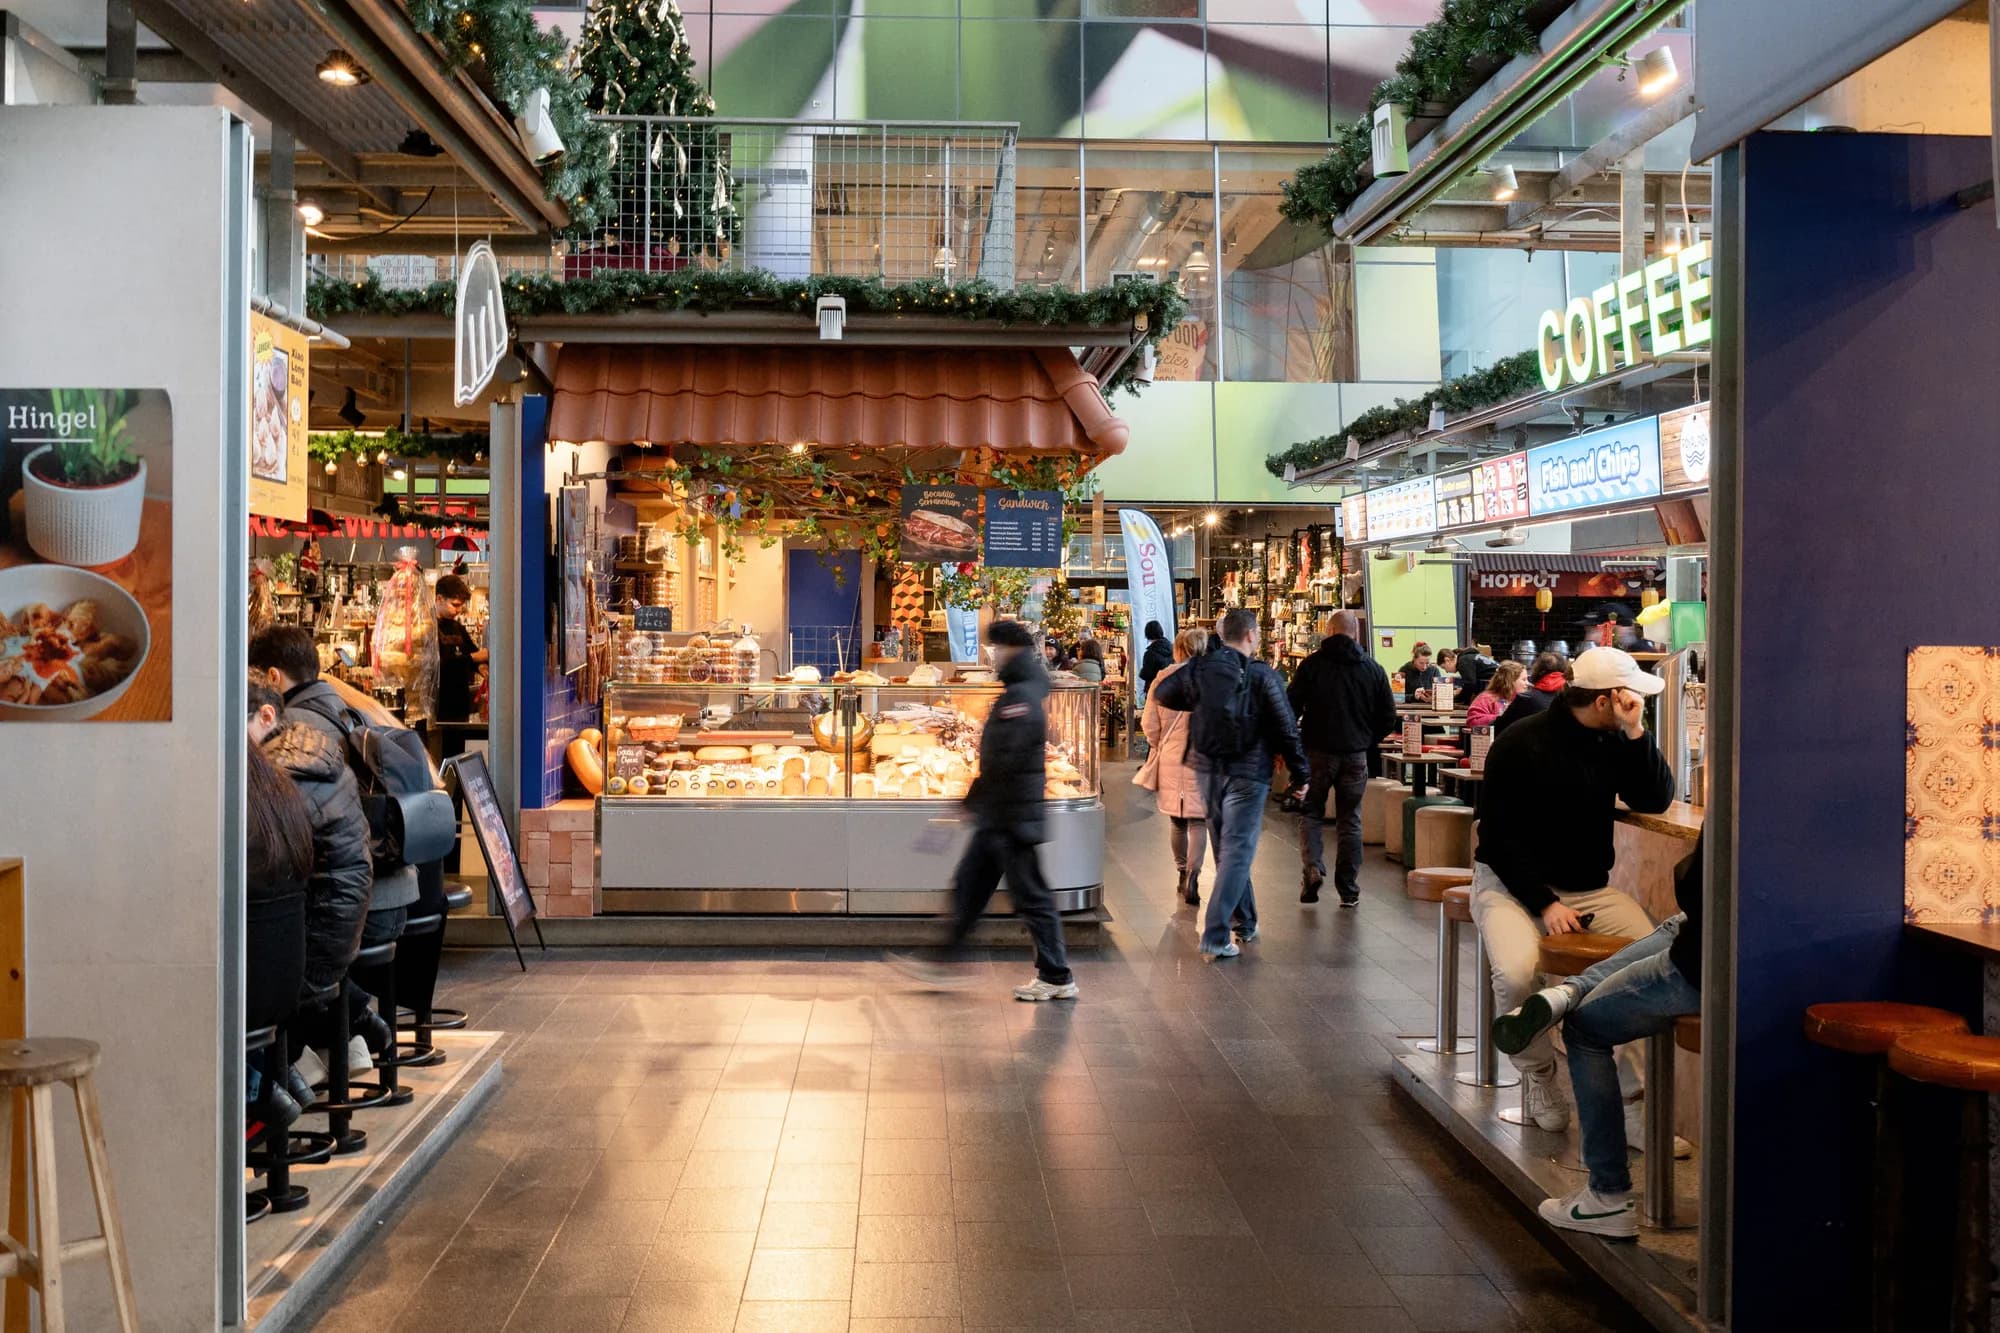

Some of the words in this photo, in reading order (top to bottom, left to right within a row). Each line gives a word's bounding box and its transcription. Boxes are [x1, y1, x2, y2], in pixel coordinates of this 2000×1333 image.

[1537, 240, 1712, 392] COFFEE
[291, 348, 304, 362] Xiao
[291, 360, 305, 378] Long
[291, 374, 303, 388] Bao
[8, 405, 96, 436] Hingel
[1541, 456, 1569, 494] Fish
[1569, 448, 1597, 488] and
[1596, 440, 1641, 486] Chips
[998, 496, 1050, 511] Sandwich
[1480, 573, 1560, 589] HOTPOT
